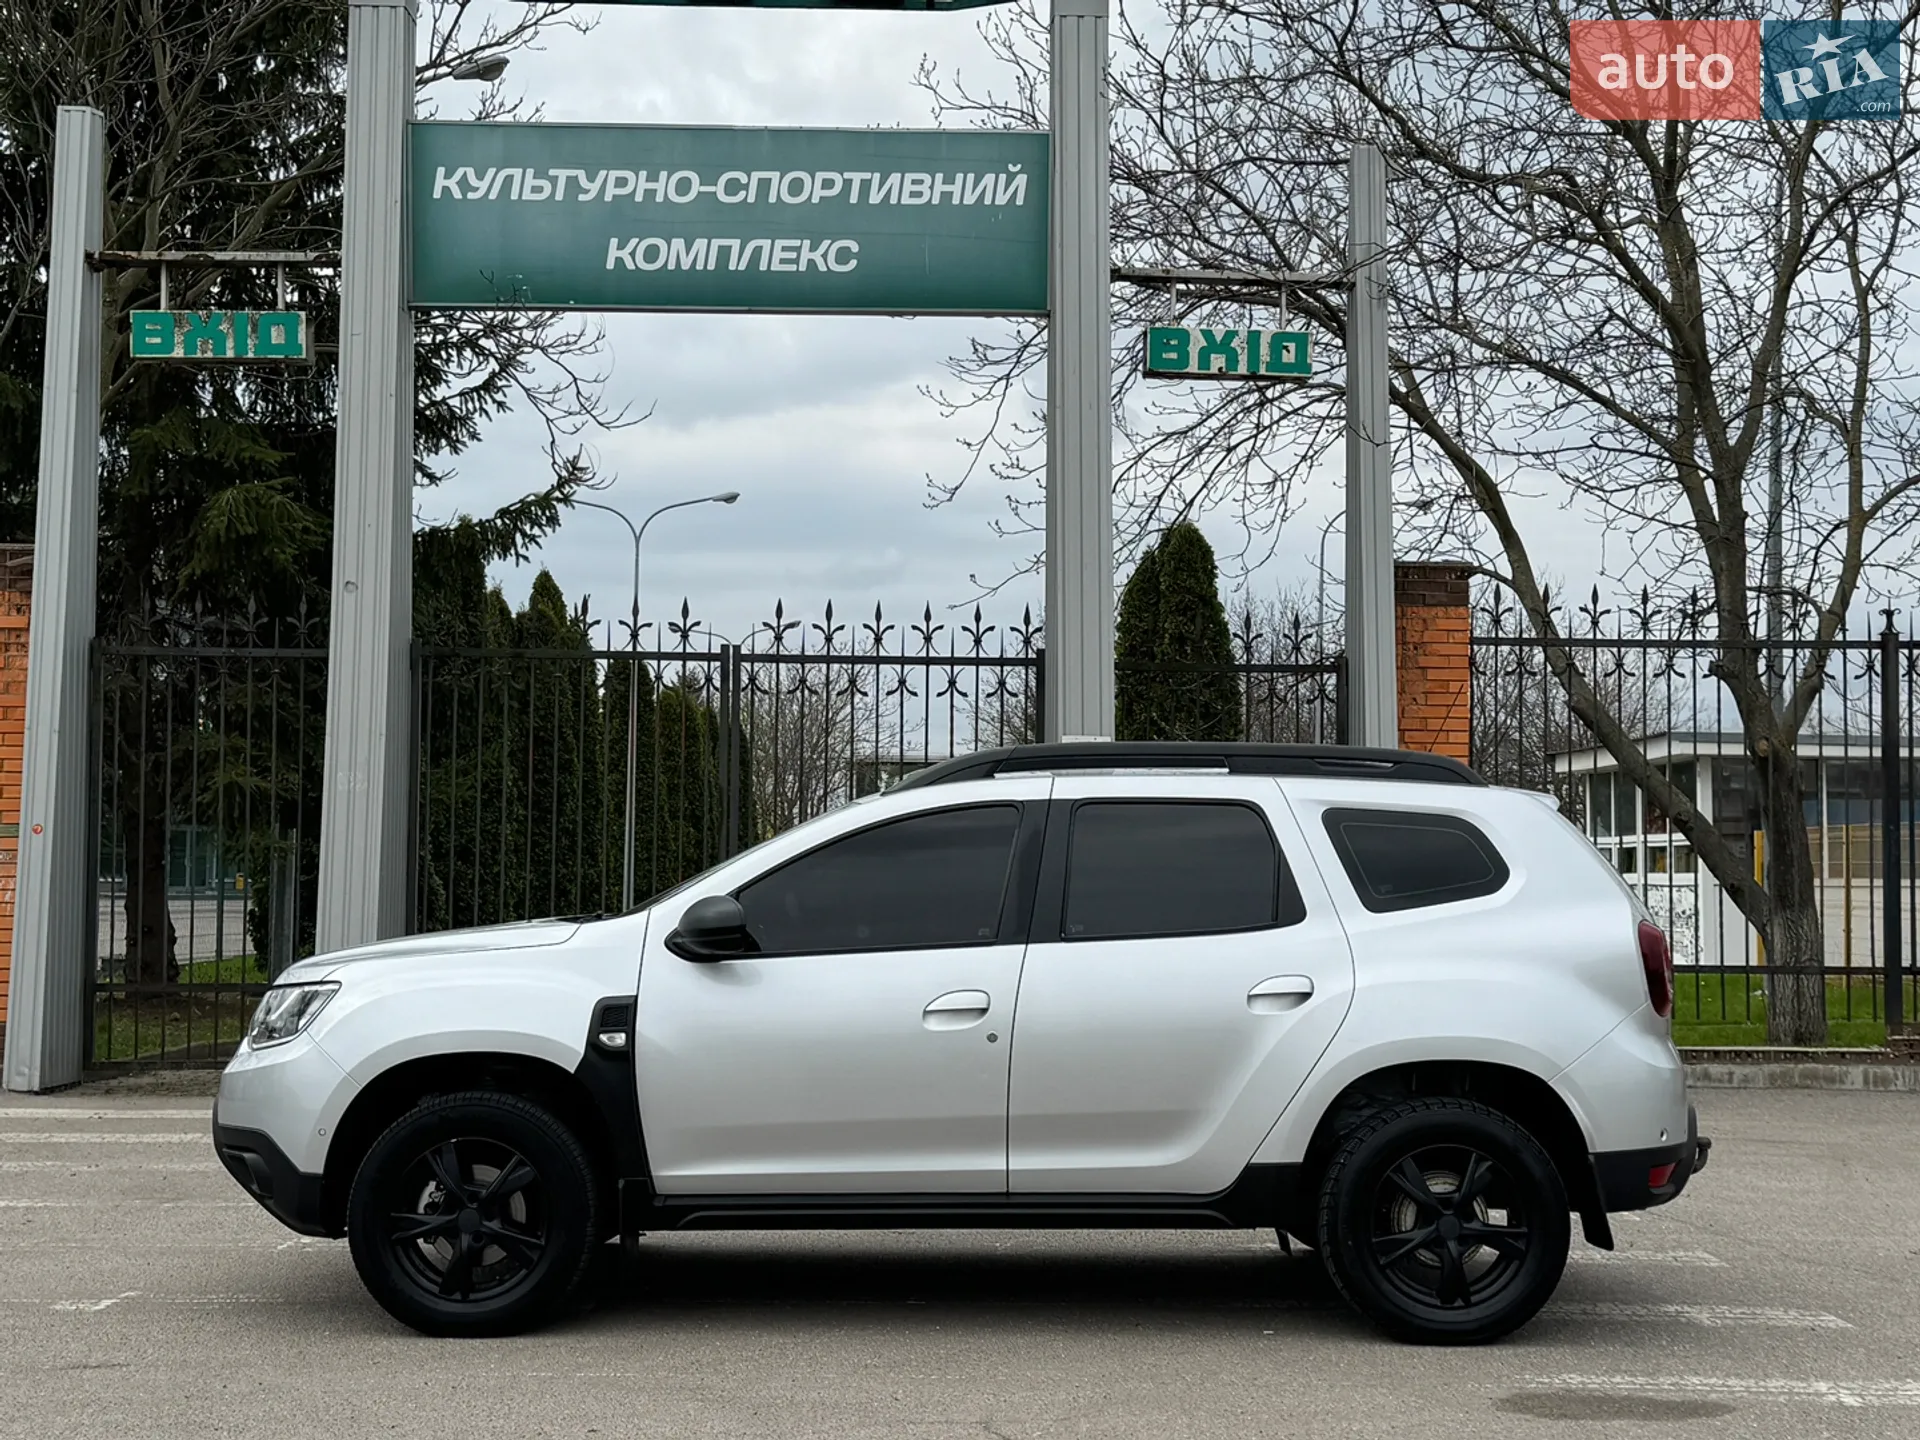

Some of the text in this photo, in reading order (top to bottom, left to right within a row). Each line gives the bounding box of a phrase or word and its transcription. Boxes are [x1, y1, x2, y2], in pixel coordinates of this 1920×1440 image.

[432, 163, 1028, 206] КУЛЬТУРНО-СПОРТИВНИЙ
[605, 237, 860, 273] КОМПЛЕКС
[132, 312, 303, 357] ВХІД
[1148, 327, 1312, 375] ВХІД
